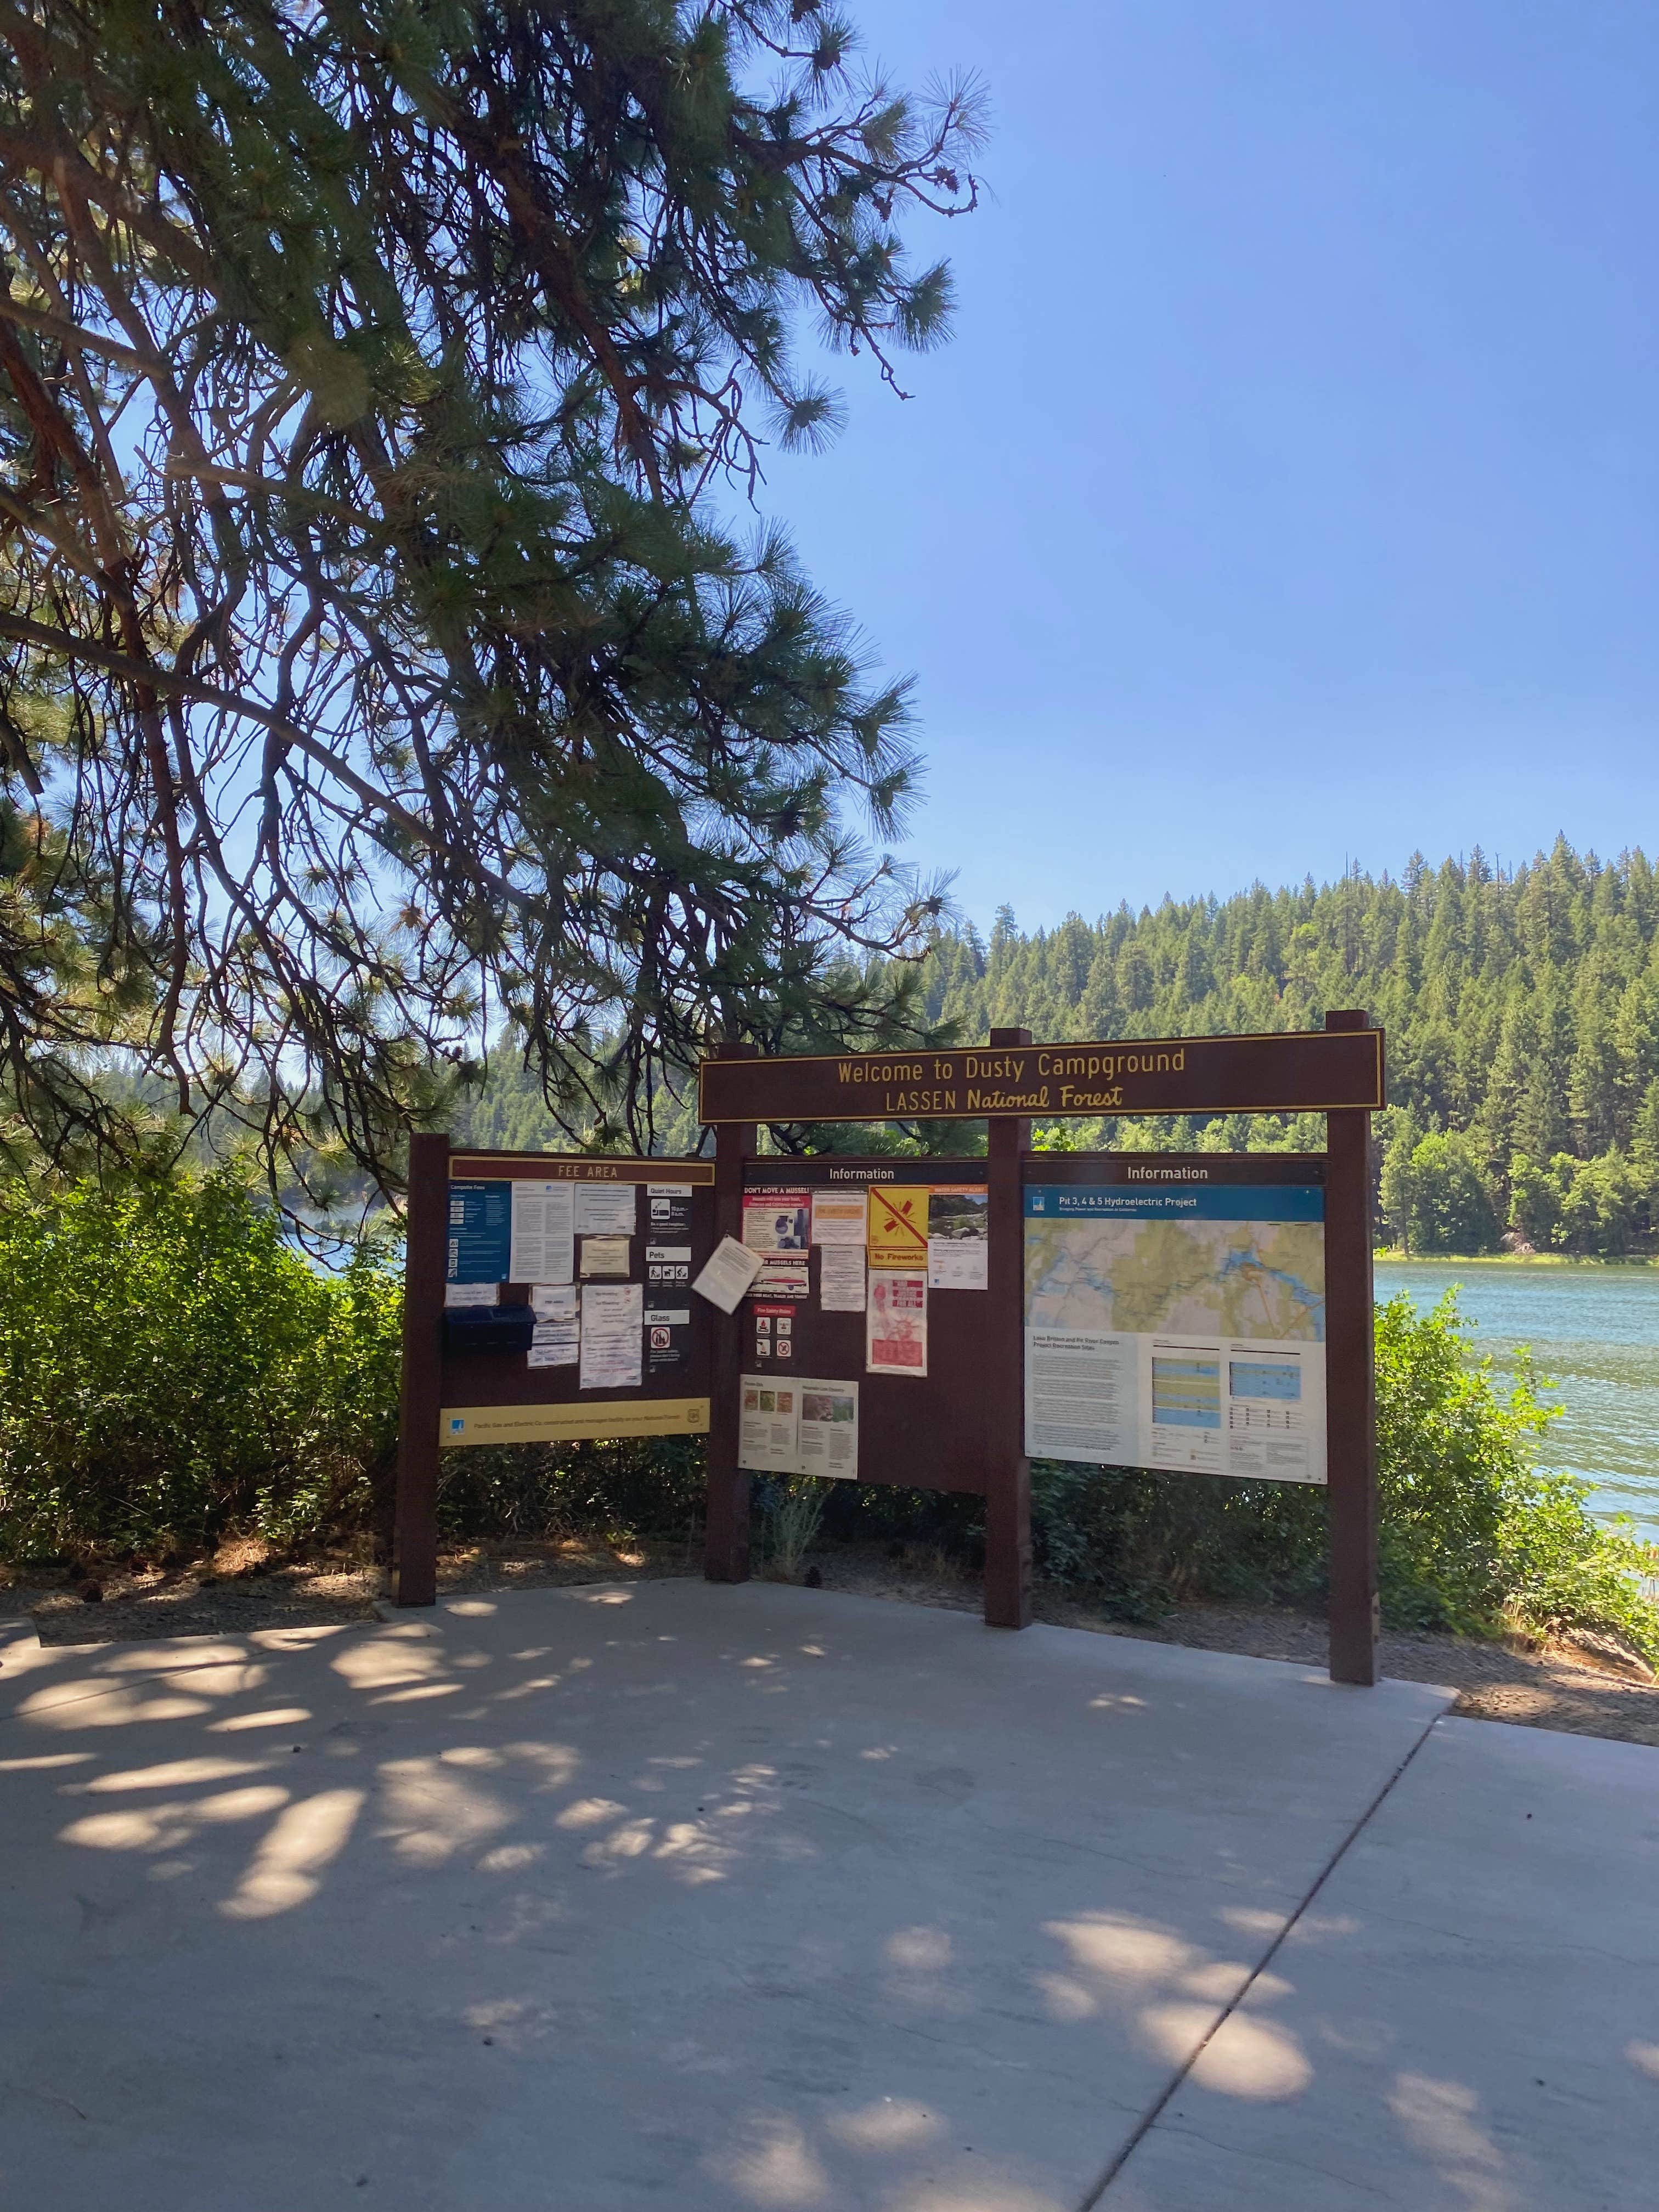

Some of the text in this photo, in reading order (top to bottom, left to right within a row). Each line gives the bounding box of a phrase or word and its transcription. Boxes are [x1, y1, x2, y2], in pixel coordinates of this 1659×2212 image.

[838, 1048, 1184, 1082] Welcome to Dusty Campground
[885, 1085, 1124, 1111] LASSEN National Forest
[558, 1165, 618, 1178] FEE AREA
[830, 1168, 895, 1180] Information
[1127, 1166, 1208, 1179] Information
[1059, 1197, 1070, 1205] Pit
[1073, 1197, 1080, 1206] 3,
[1089, 1197, 1095, 1205] &
[1104, 1197, 1163, 1207] Hydroelectric
[1165, 1198, 1197, 1207] Project
